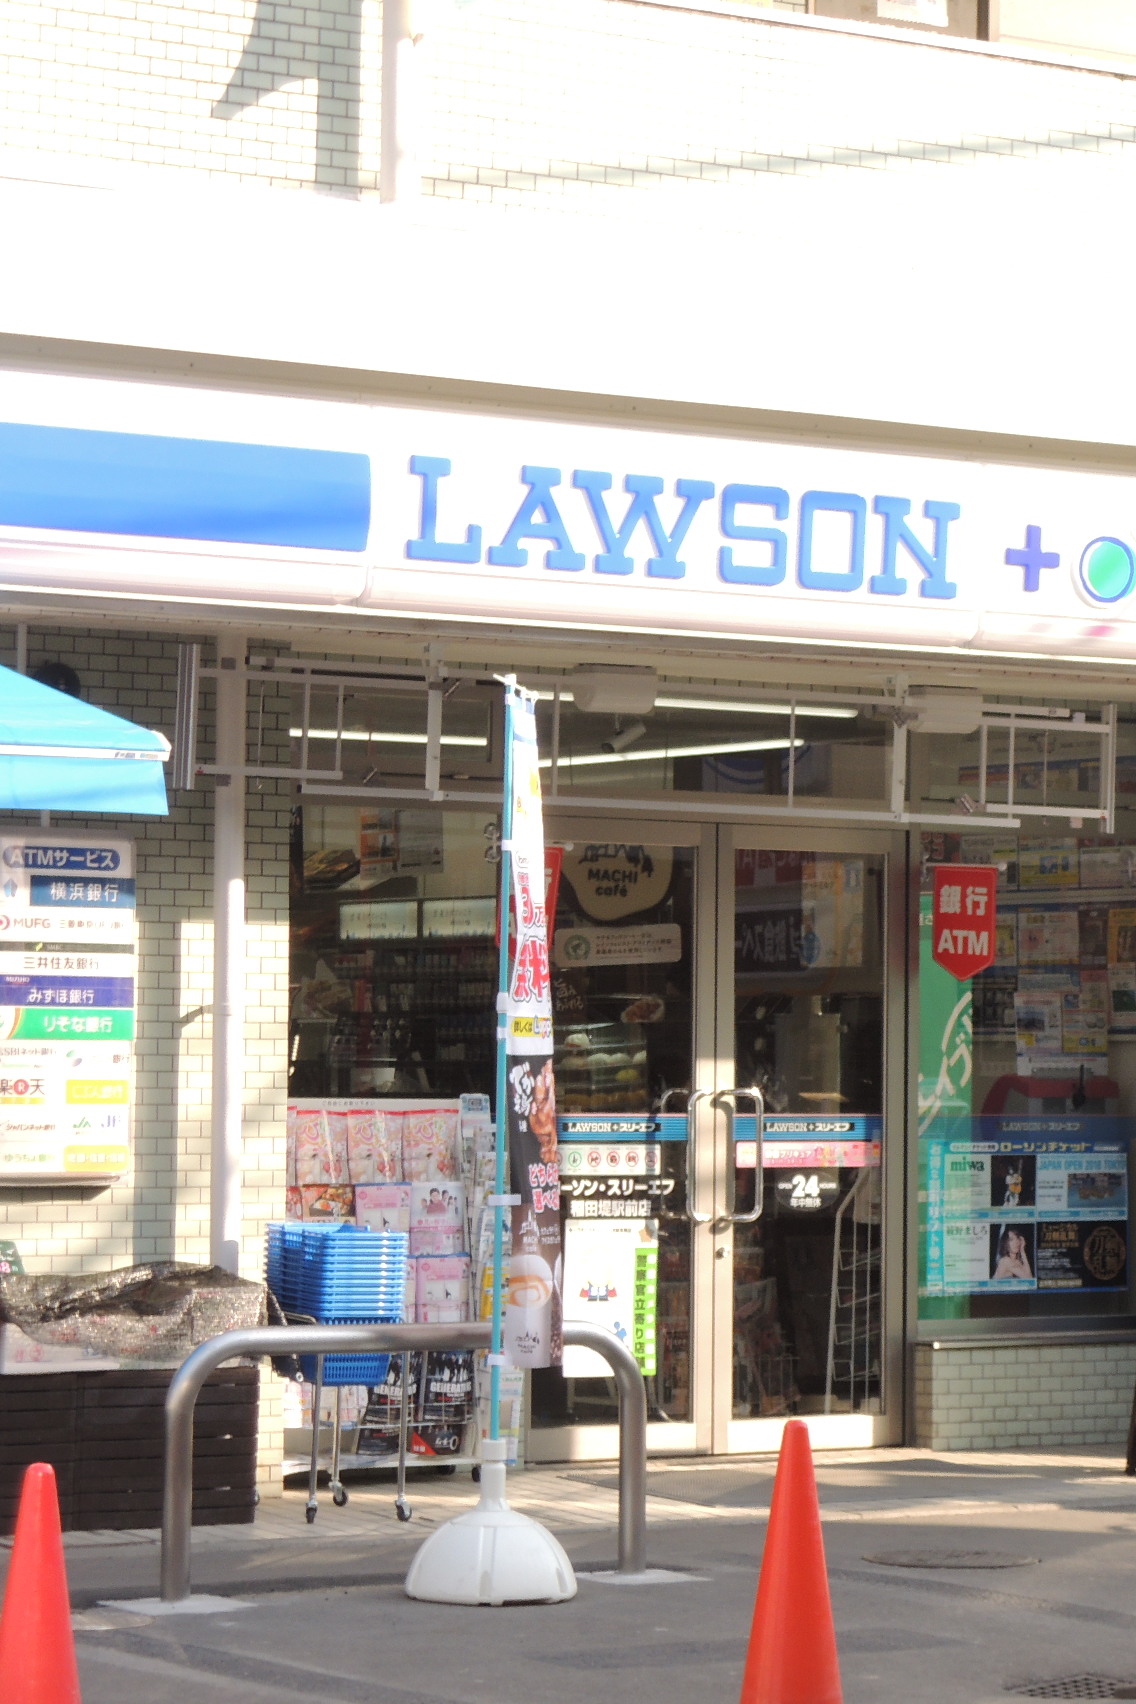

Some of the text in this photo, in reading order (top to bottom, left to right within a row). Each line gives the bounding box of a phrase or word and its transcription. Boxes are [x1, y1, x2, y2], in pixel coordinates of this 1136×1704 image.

[406, 454, 961, 600] LAWSON
[10, 848, 116, 868] ATMサービス
[588, 868, 638, 883] MACHI
[50, 882, 120, 903] 横浜銀行
[939, 885, 988, 917] 銀行
[13, 918, 52, 929] MUFG
[937, 929, 989, 956] ATM
[23, 956, 100, 970] 三井住友銀行
[27, 988, 95, 1004] みずほ銀行
[44, 1015, 113, 1033] りそな銀行
[568, 1122, 611, 1132] LAWSON
[620, 1123, 656, 1132] スリーエフ
[766, 1122, 807, 1132] LAWSON
[815, 1122, 850, 1132] スリーエフ
[1000, 1141, 1092, 1152] ローソンチケット
[950, 1156, 985, 1172] miwa
[560, 1179, 675, 1196] ーソン・スリーエフ
[792, 1175, 820, 1197] 24
[571, 1199, 652, 1217] 稲田堤駅前店
